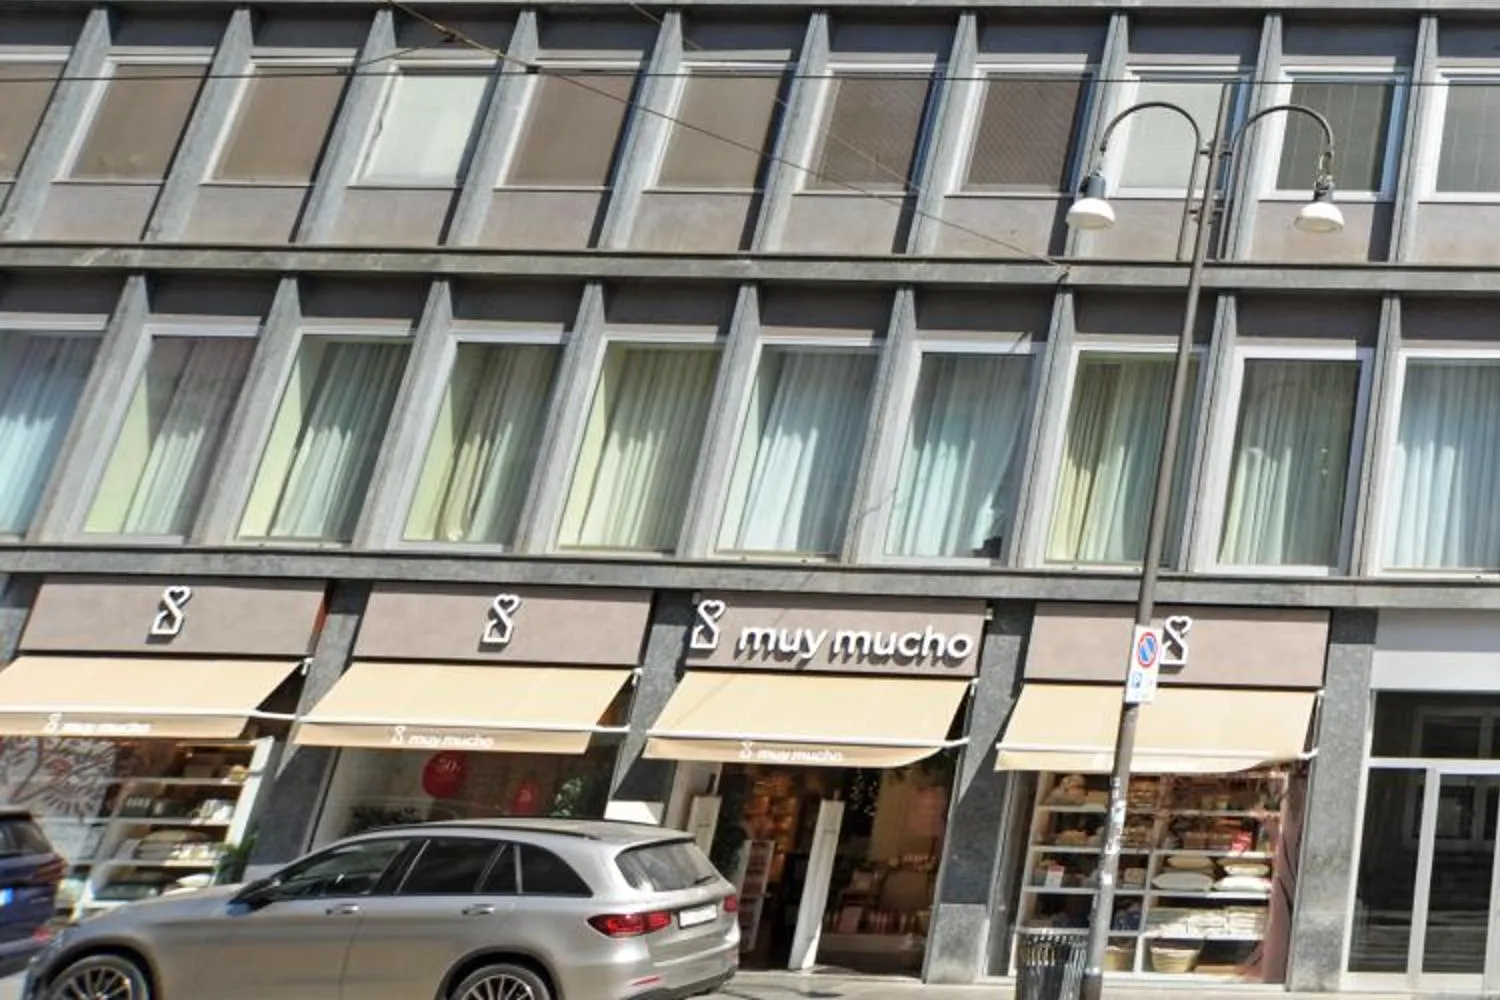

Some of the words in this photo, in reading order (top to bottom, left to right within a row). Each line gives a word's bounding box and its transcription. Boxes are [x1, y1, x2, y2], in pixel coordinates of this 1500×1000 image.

[739, 625, 827, 658] muy
[833, 625, 973, 658] mucho
[408, 735, 441, 747] muy
[442, 733, 495, 747] mucho
[756, 749, 794, 761] muy
[794, 750, 843, 762] mucho
